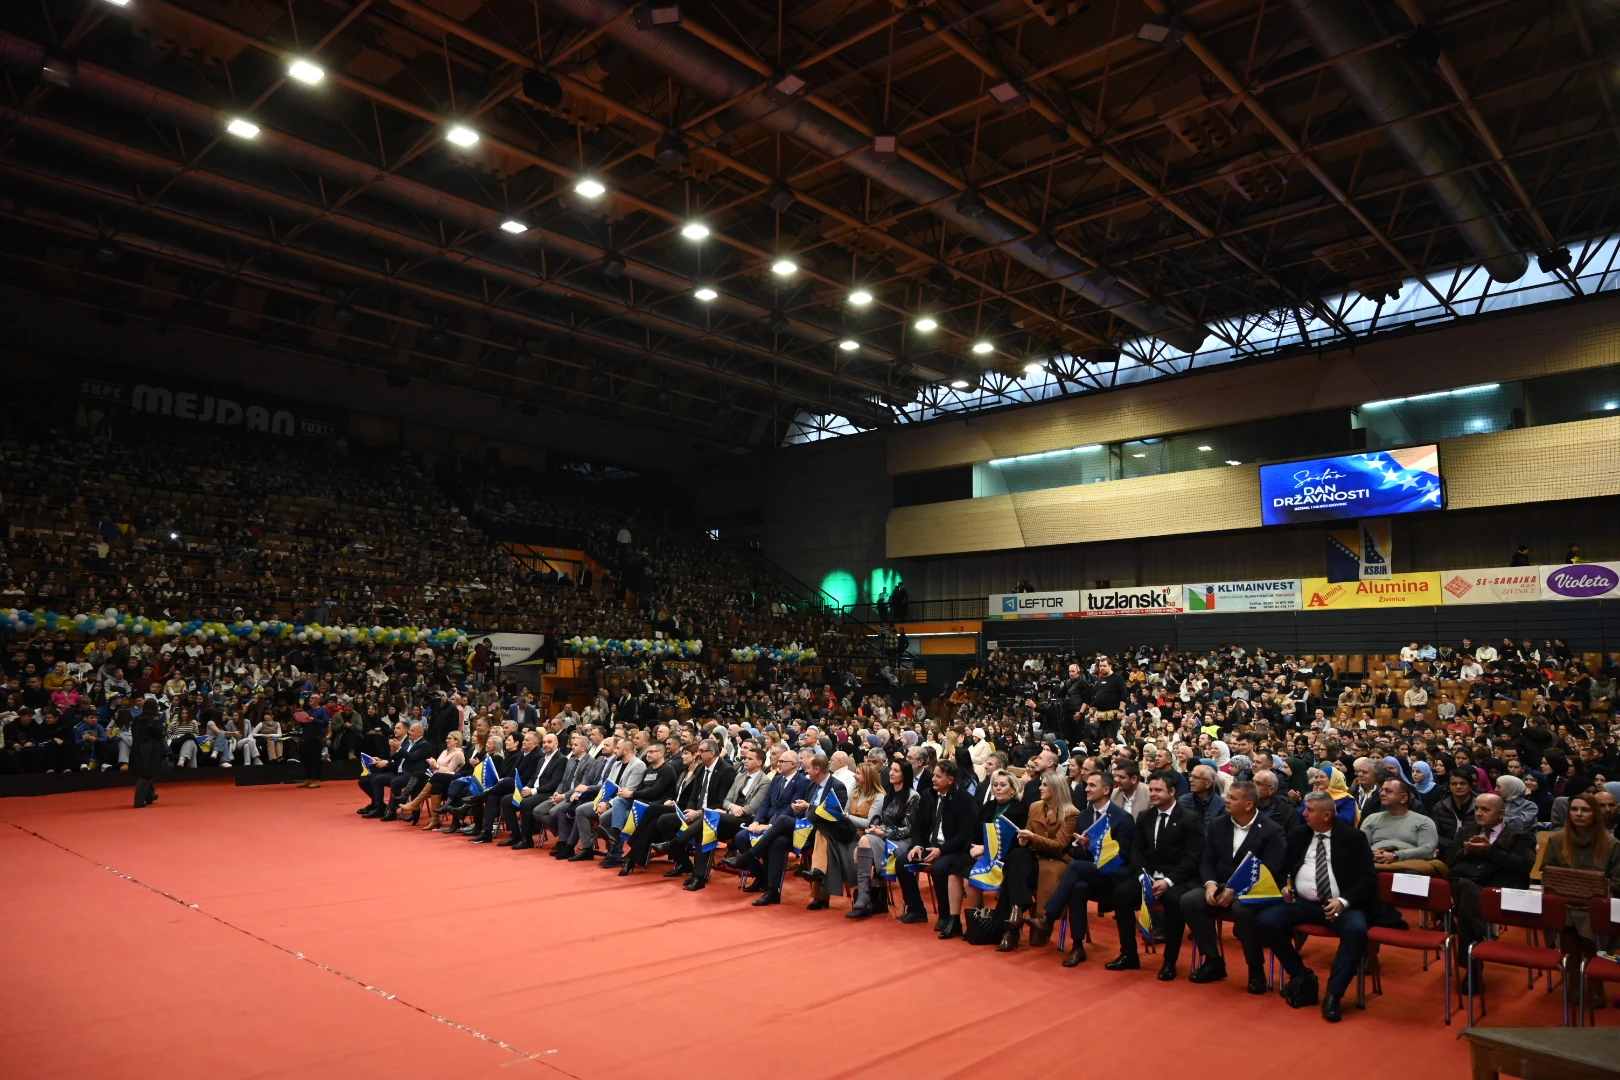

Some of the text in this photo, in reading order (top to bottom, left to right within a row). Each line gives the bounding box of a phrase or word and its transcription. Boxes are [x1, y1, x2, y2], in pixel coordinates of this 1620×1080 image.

[131, 383, 295, 437] MEJDAN
[1273, 488, 1370, 507] DRŽAVNOSTI
[1303, 484, 1336, 496] DAN
[1218, 581, 1295, 593] KLIMAINVEST
[1356, 580, 1429, 594] Alumina
[1554, 573, 1611, 589] Violeta
[1019, 597, 1064, 609] LEFTOR
[1088, 588, 1167, 610] tuzlanski
